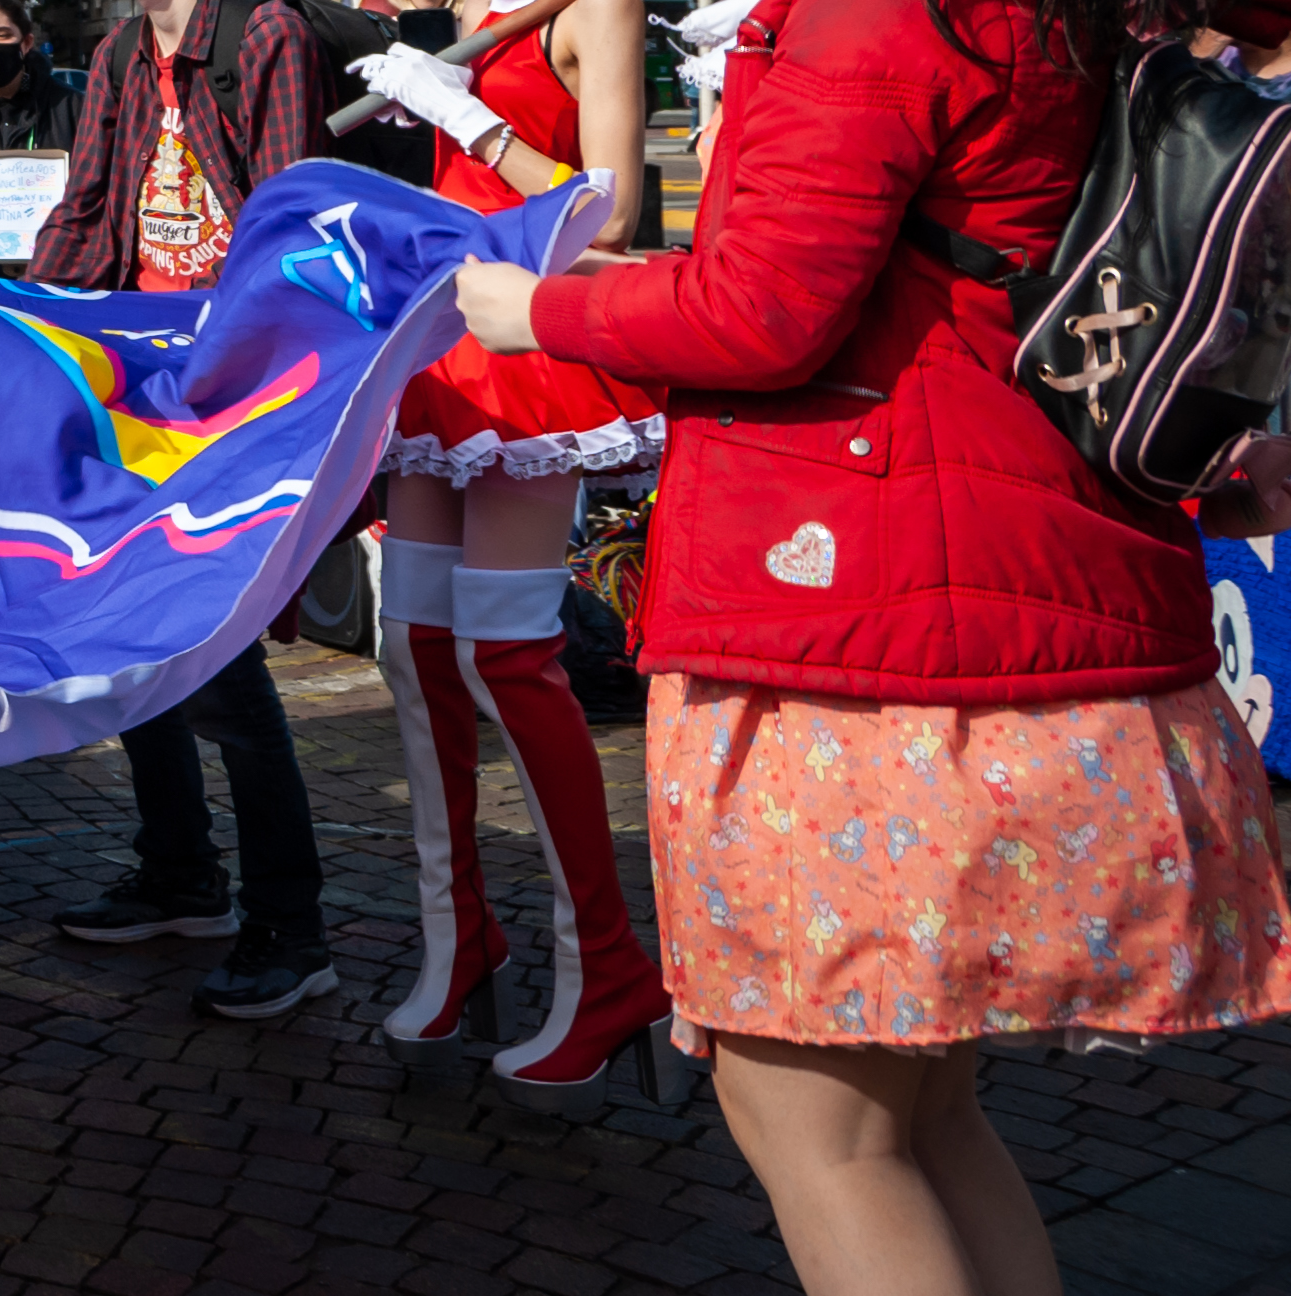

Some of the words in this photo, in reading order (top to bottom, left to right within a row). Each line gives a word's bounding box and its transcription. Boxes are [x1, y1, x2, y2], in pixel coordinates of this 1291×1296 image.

[39, 194, 52, 202] EN
[145, 221, 198, 241] nugget
[177, 227, 233, 277] SAUCE
